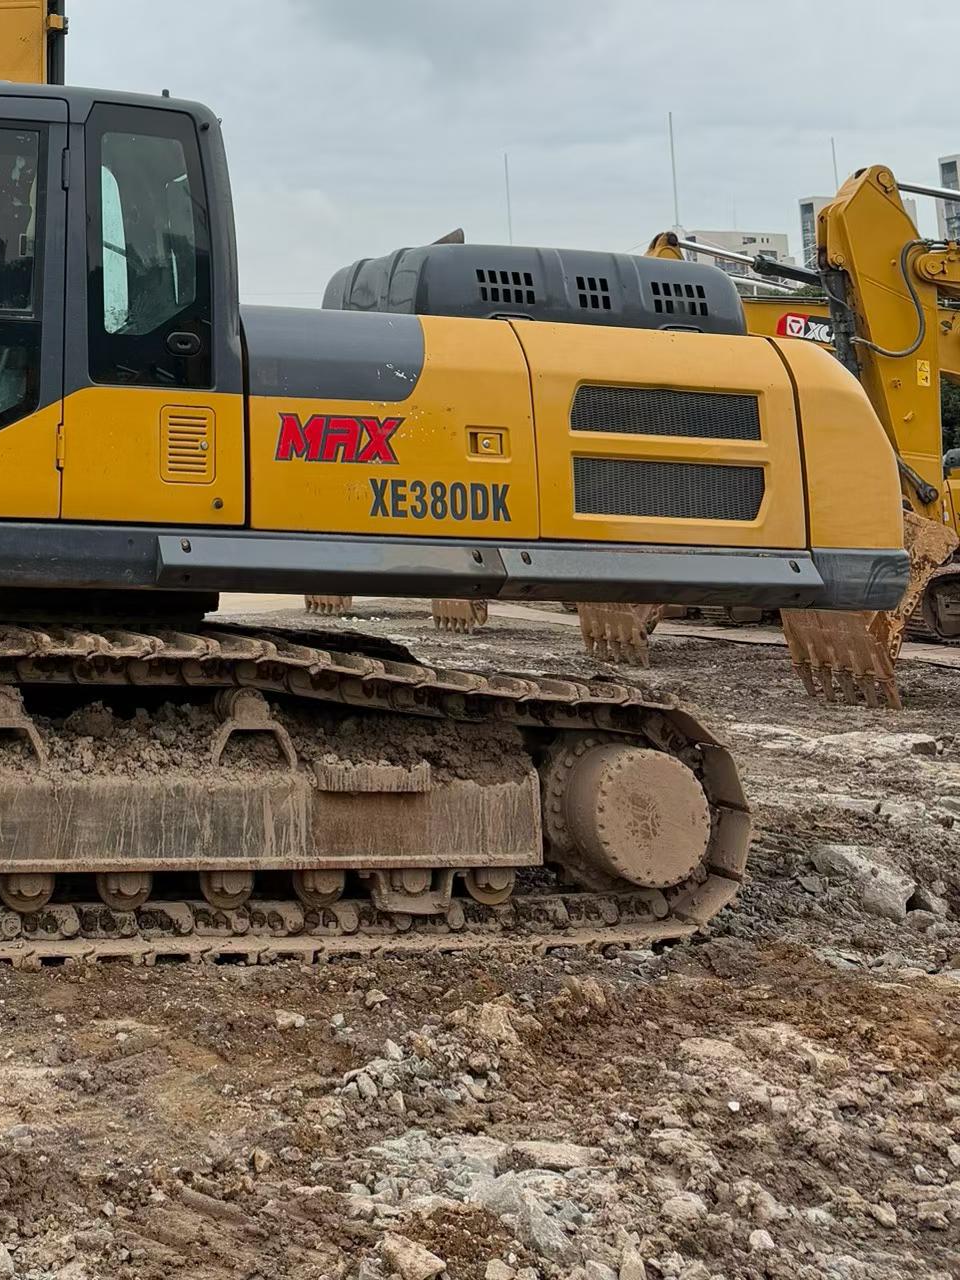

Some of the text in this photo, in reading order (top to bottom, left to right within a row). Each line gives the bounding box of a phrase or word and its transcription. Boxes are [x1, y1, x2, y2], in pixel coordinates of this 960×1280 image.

[806, 321, 836, 343] XC
[274, 413, 406, 464] MAX
[369, 478, 513, 522] XE380DK
